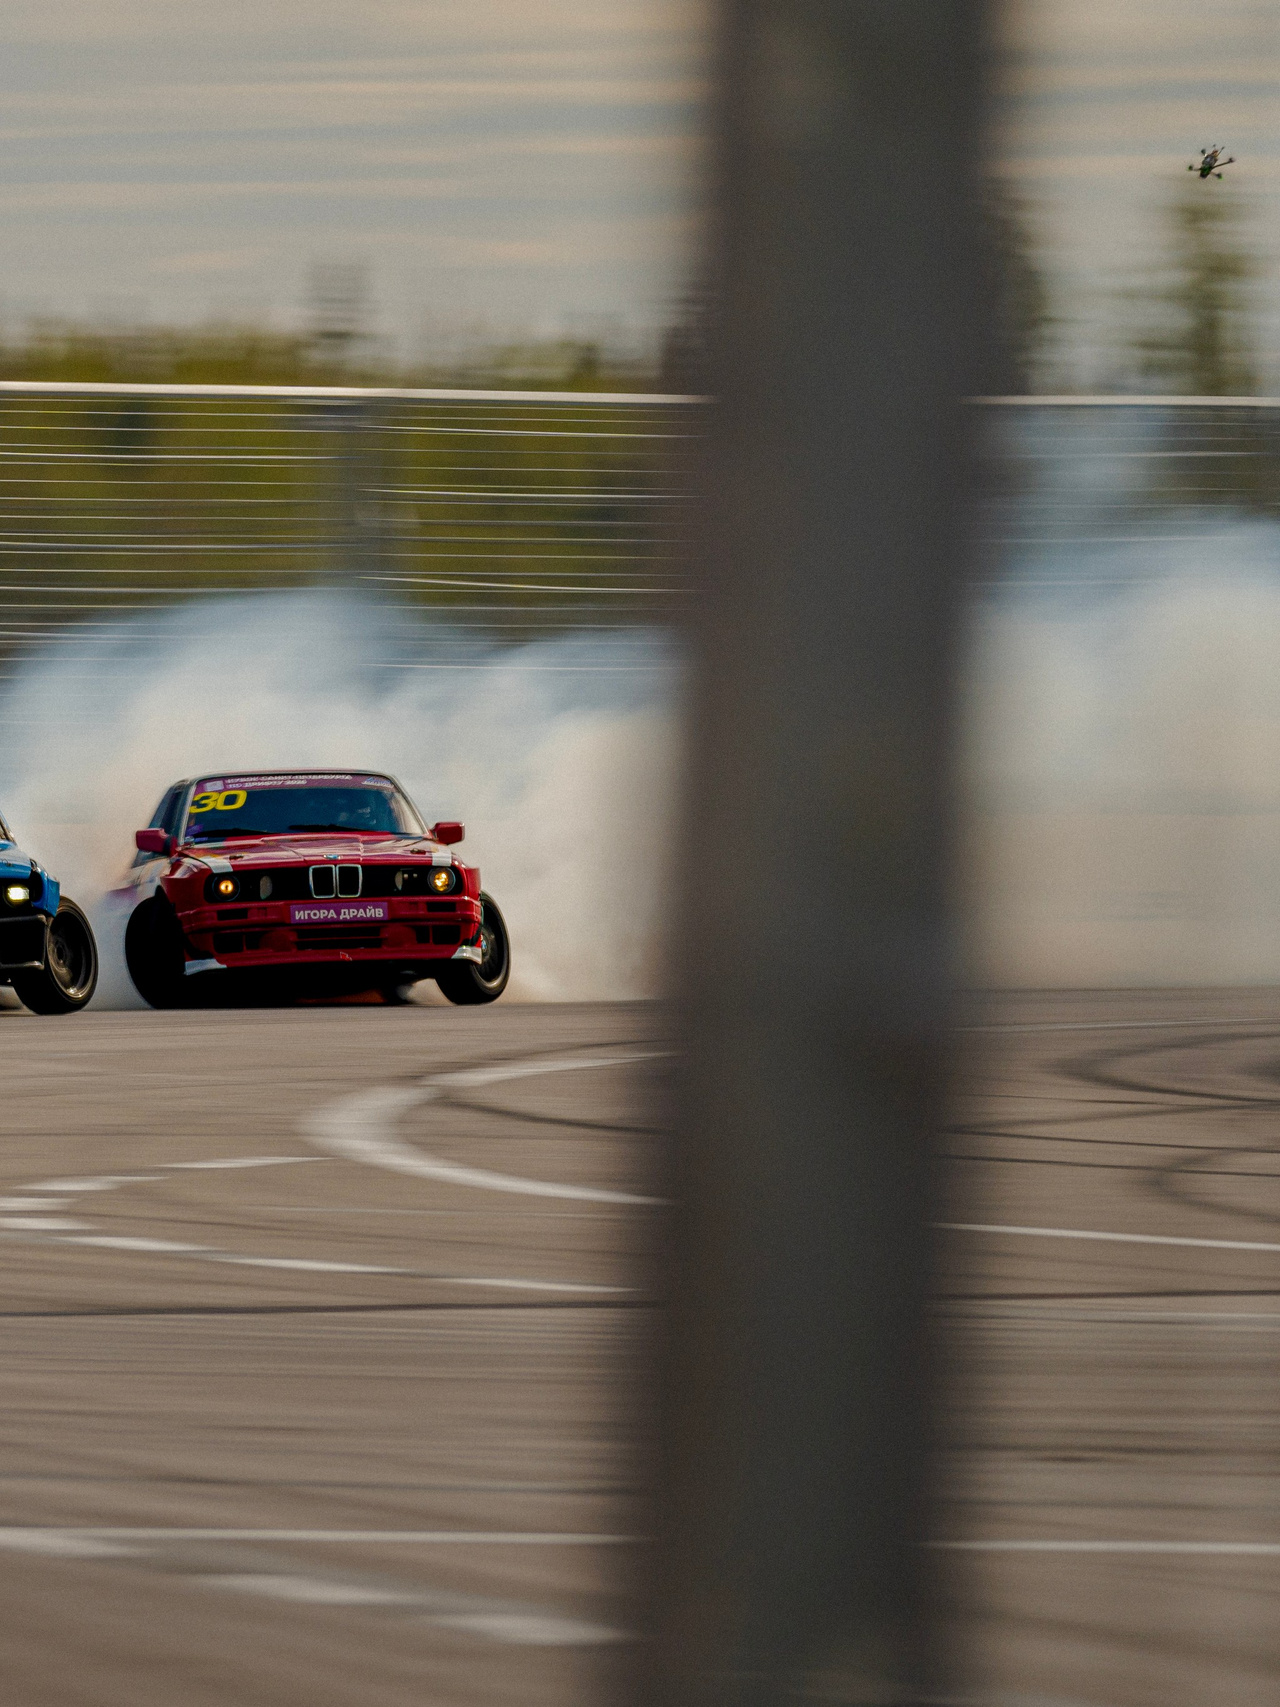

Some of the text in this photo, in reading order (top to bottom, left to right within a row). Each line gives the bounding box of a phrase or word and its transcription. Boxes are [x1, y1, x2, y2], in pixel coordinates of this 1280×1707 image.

[189, 790, 247, 814] 30
[295, 905, 384, 920] ИГОРА ДРАЙВ
